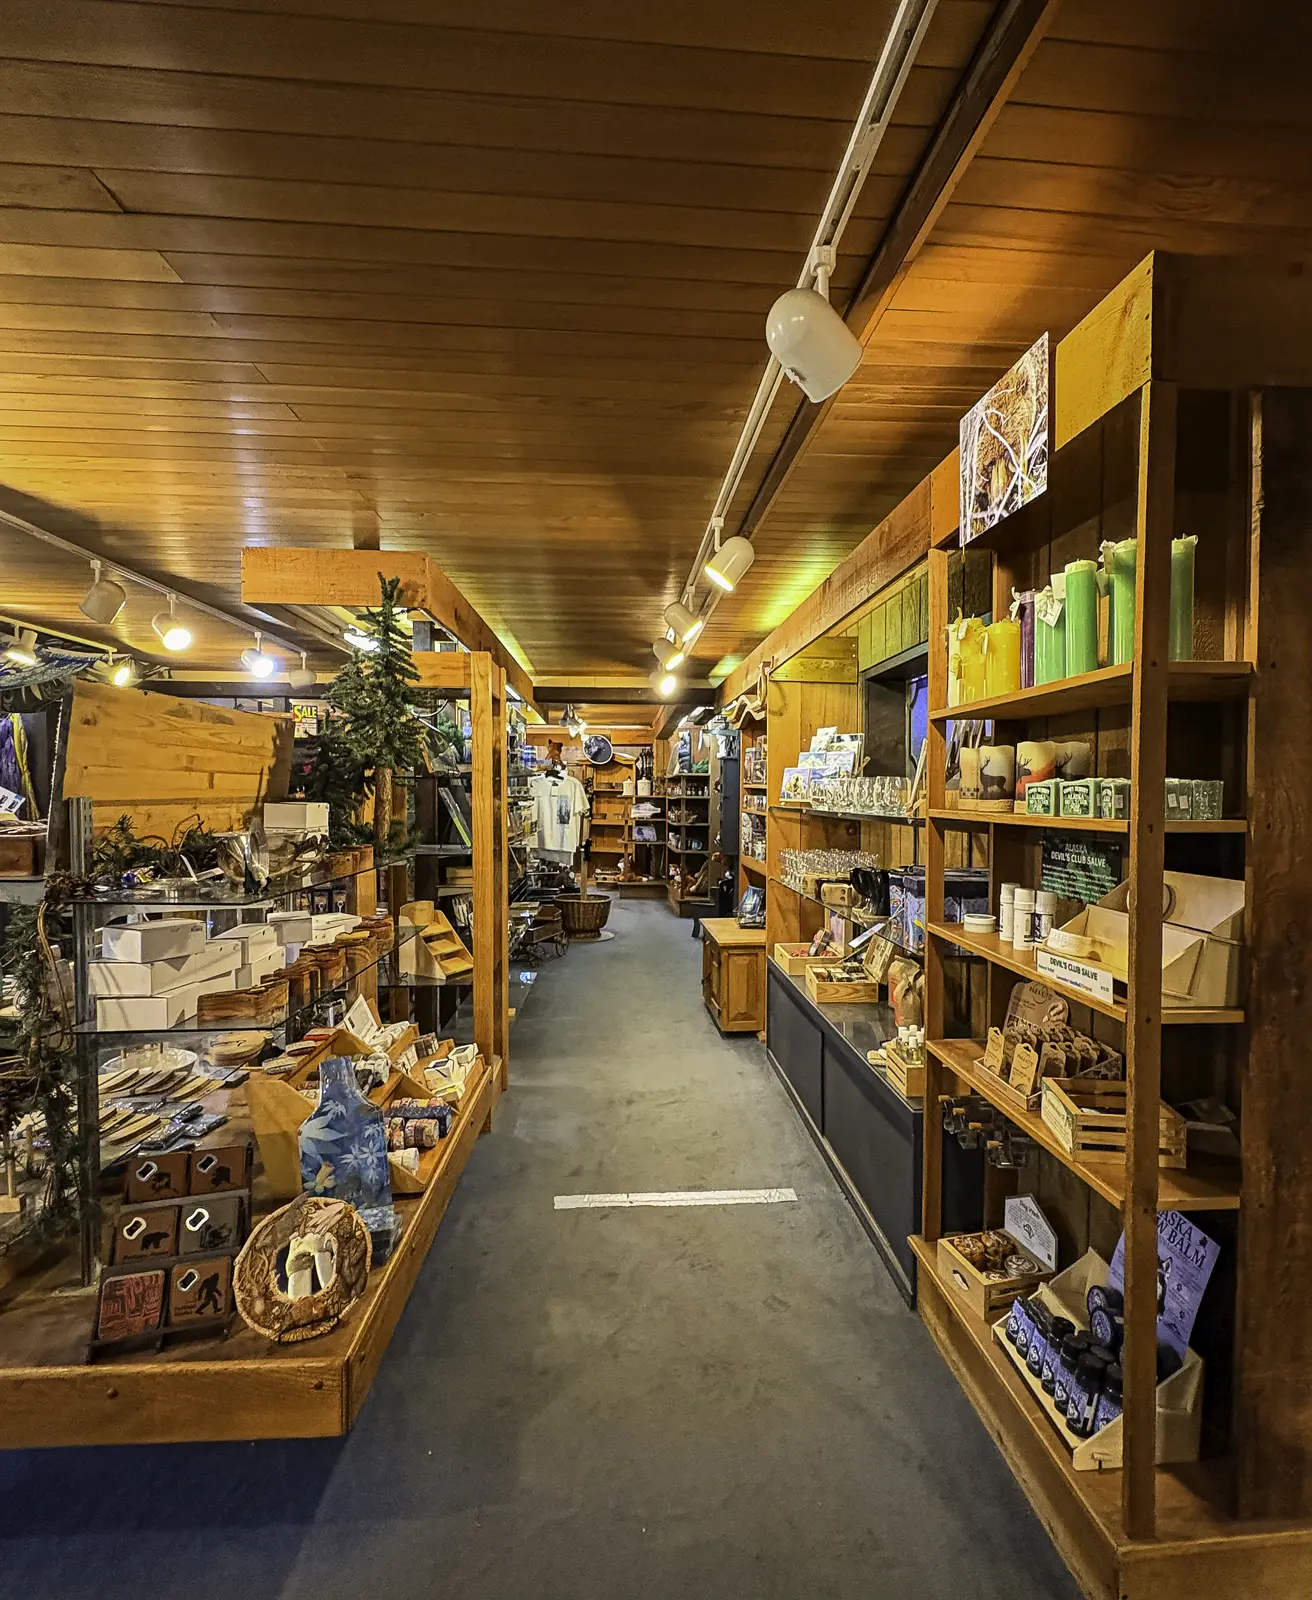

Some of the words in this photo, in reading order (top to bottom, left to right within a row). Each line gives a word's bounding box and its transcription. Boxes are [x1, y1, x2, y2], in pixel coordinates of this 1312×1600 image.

[293, 705, 317, 722] SALE
[1065, 843, 1088, 854] ALASKA
[1051, 851, 1070, 862] DEVIL'S
[1071, 854, 1086, 864] CLUB
[1087, 857, 1106, 868] SALVE
[1050, 957, 1067, 970] DEVIL'S
[1068, 964, 1081, 975] CLUB
[1082, 968, 1098, 981] SALVE
[1157, 1211, 1193, 1242] ASKA
[1167, 1229, 1206, 1268] BALM
